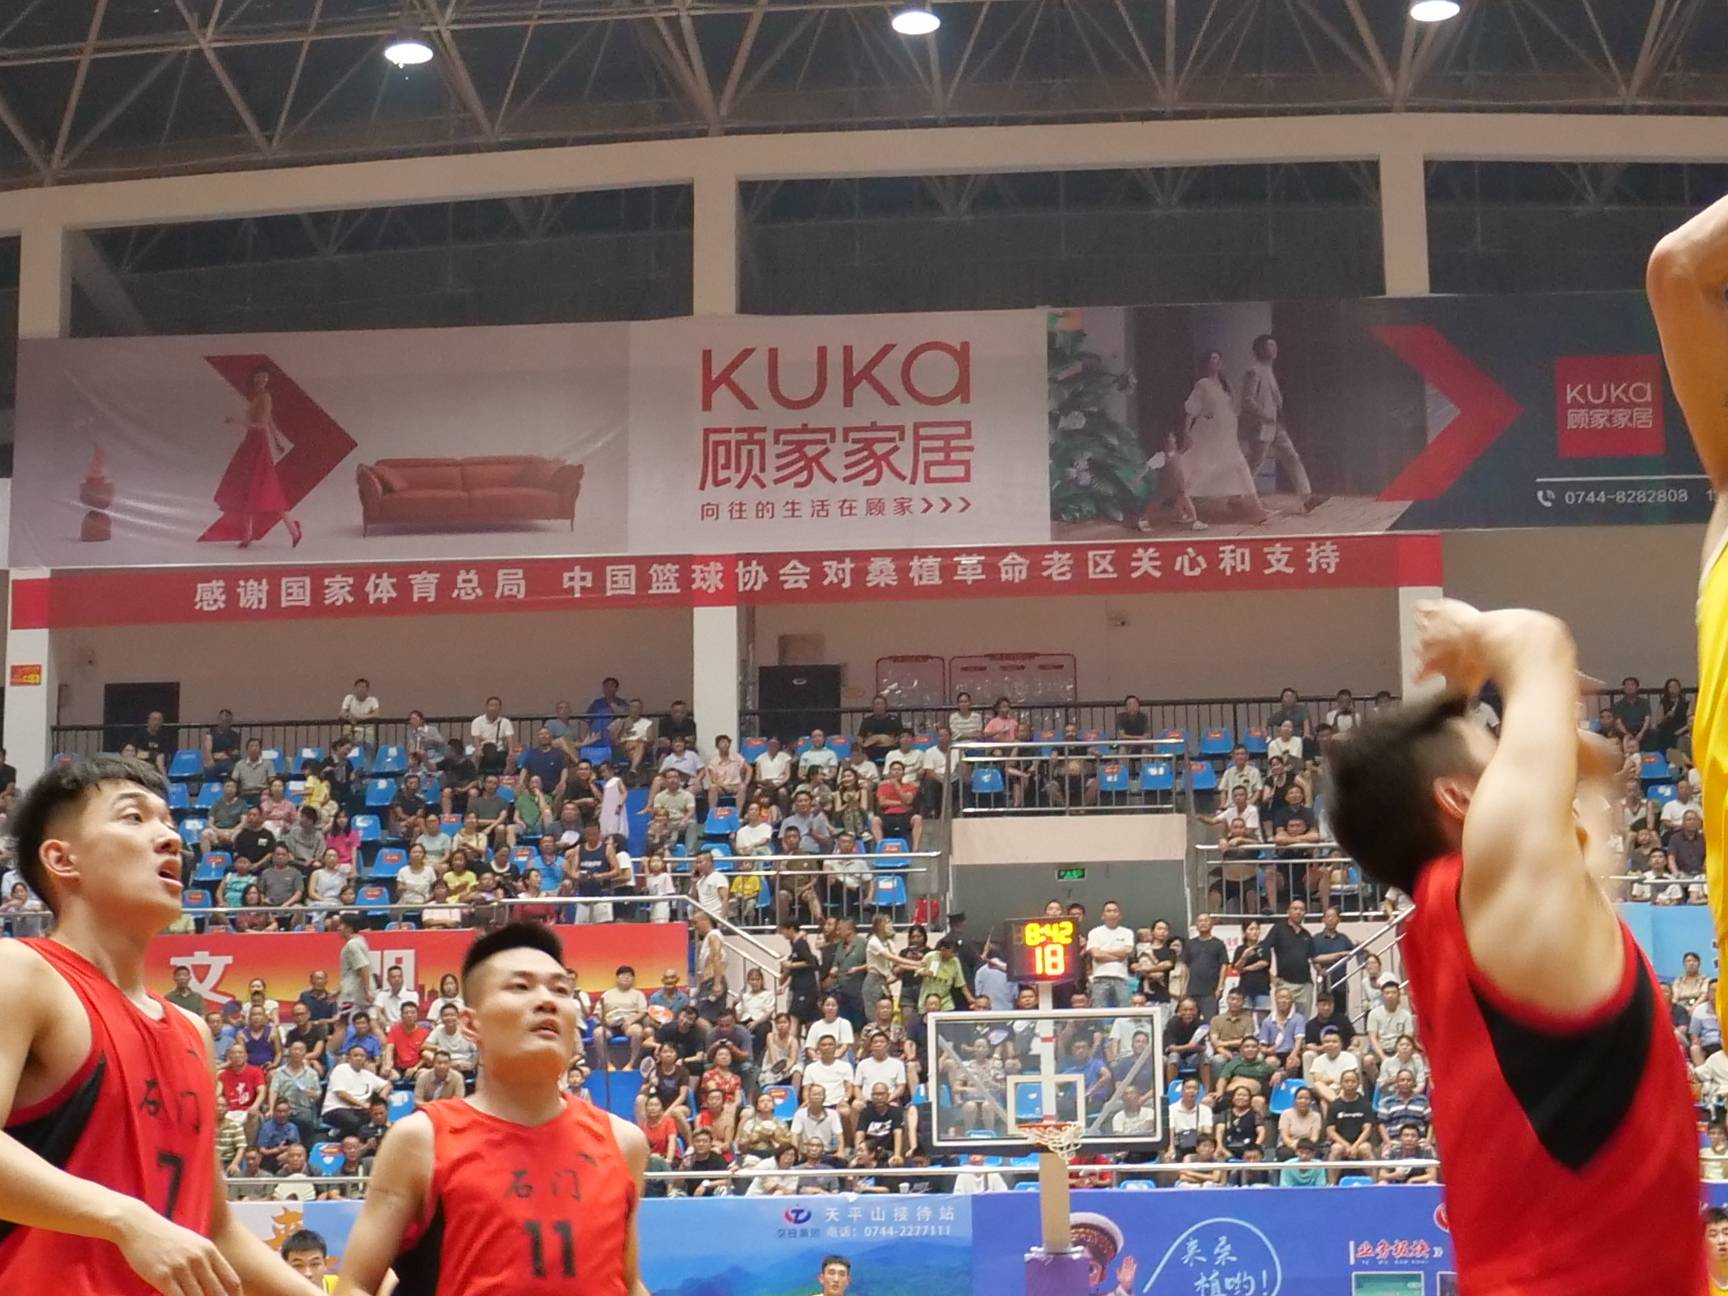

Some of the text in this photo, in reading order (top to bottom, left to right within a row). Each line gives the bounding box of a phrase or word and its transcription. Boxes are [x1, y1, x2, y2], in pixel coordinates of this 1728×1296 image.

[1566, 408, 1654, 430] 顾家家居
[697, 419, 975, 492] 顾家家居
[1564, 488, 1689, 505] 0744-8282808
[193, 538, 1343, 613] 感谢国家体育总局 中国篮球协会对桑植革命老区关心和支持
[1024, 920, 1074, 946] 8:42
[1034, 944, 1066, 976] 18
[156, 1151, 184, 1221] 7
[504, 1167, 582, 1202] 石门
[824, 1205, 956, 1223] 天平山接待站
[525, 1220, 577, 1279] 11
[1355, 1238, 1432, 1260] 业务板块
